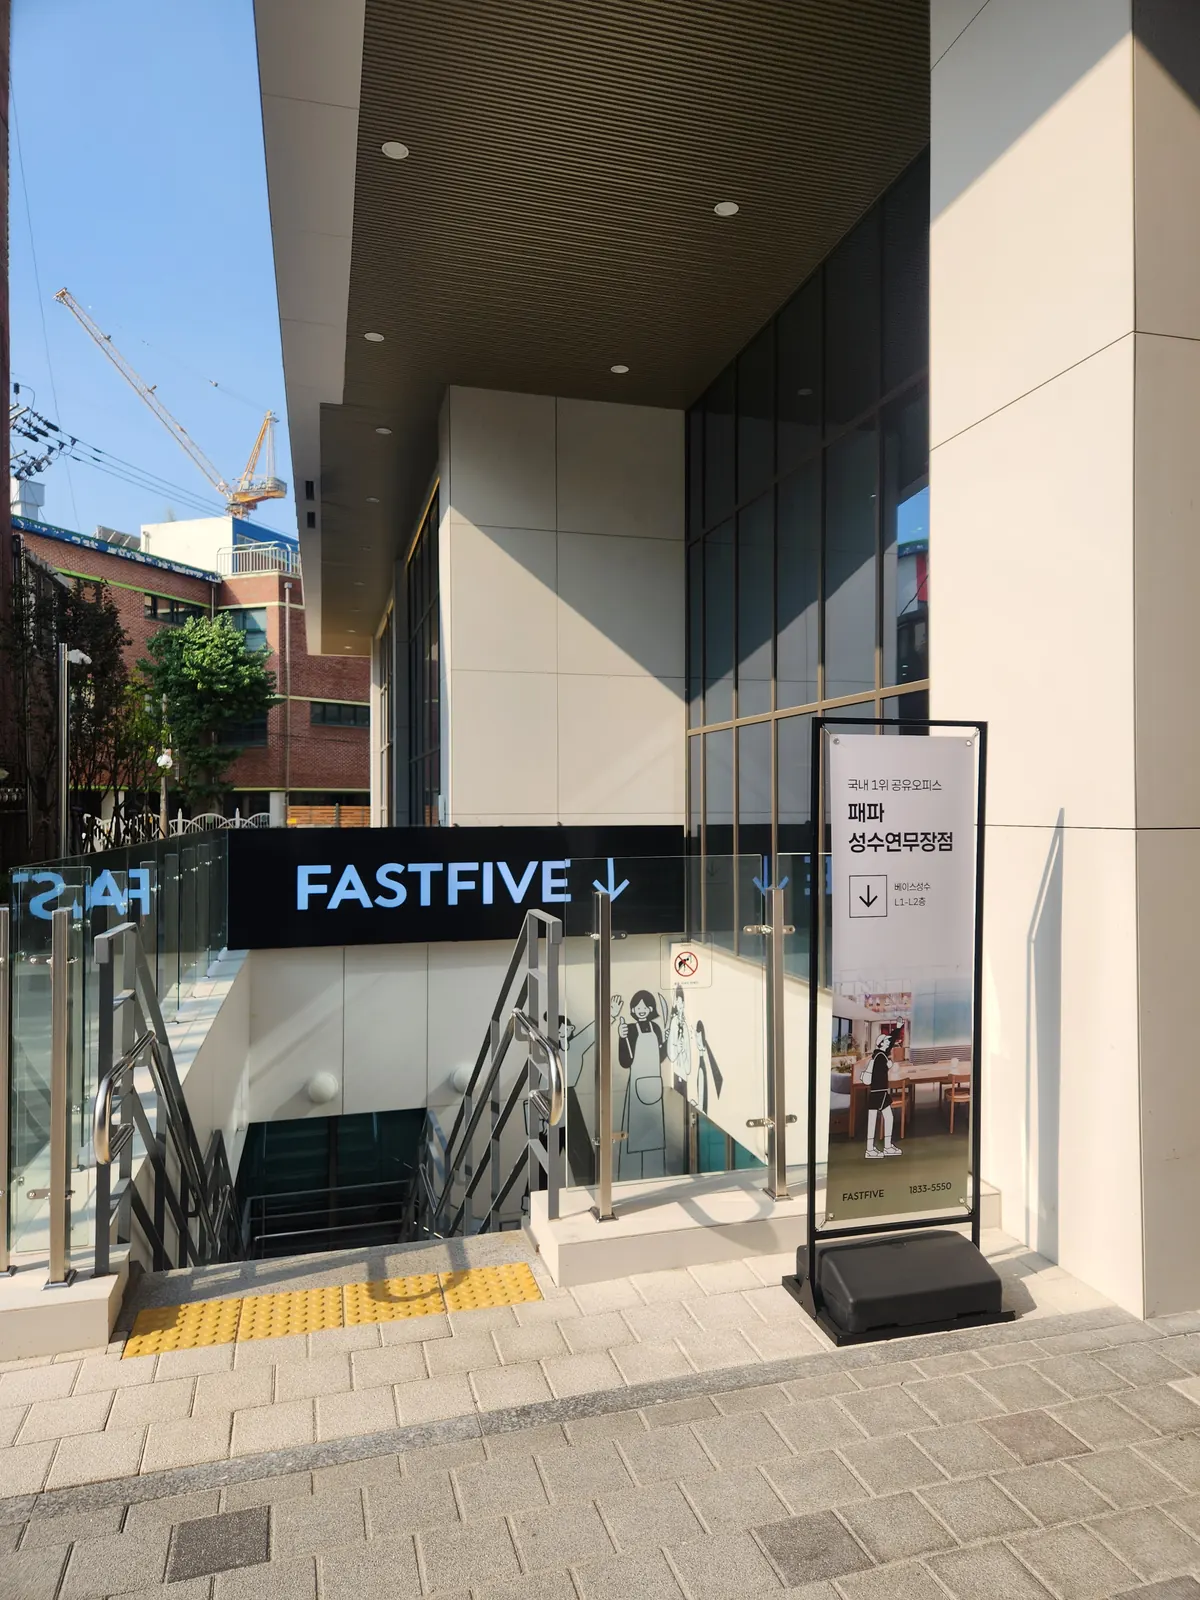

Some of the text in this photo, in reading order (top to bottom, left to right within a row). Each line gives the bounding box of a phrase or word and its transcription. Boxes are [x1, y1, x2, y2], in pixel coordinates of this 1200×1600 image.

[848, 779, 942, 792] 국내 1위 공유오피스
[848, 803, 885, 823] 패파
[849, 832, 953, 853] 성수연무장점
[296, 859, 572, 911] FASTFIVE
[894, 882, 931, 892] 베이스성수
[909, 1182, 952, 1194] 1833-5550
[842, 1189, 884, 1202] FASTFIVE
